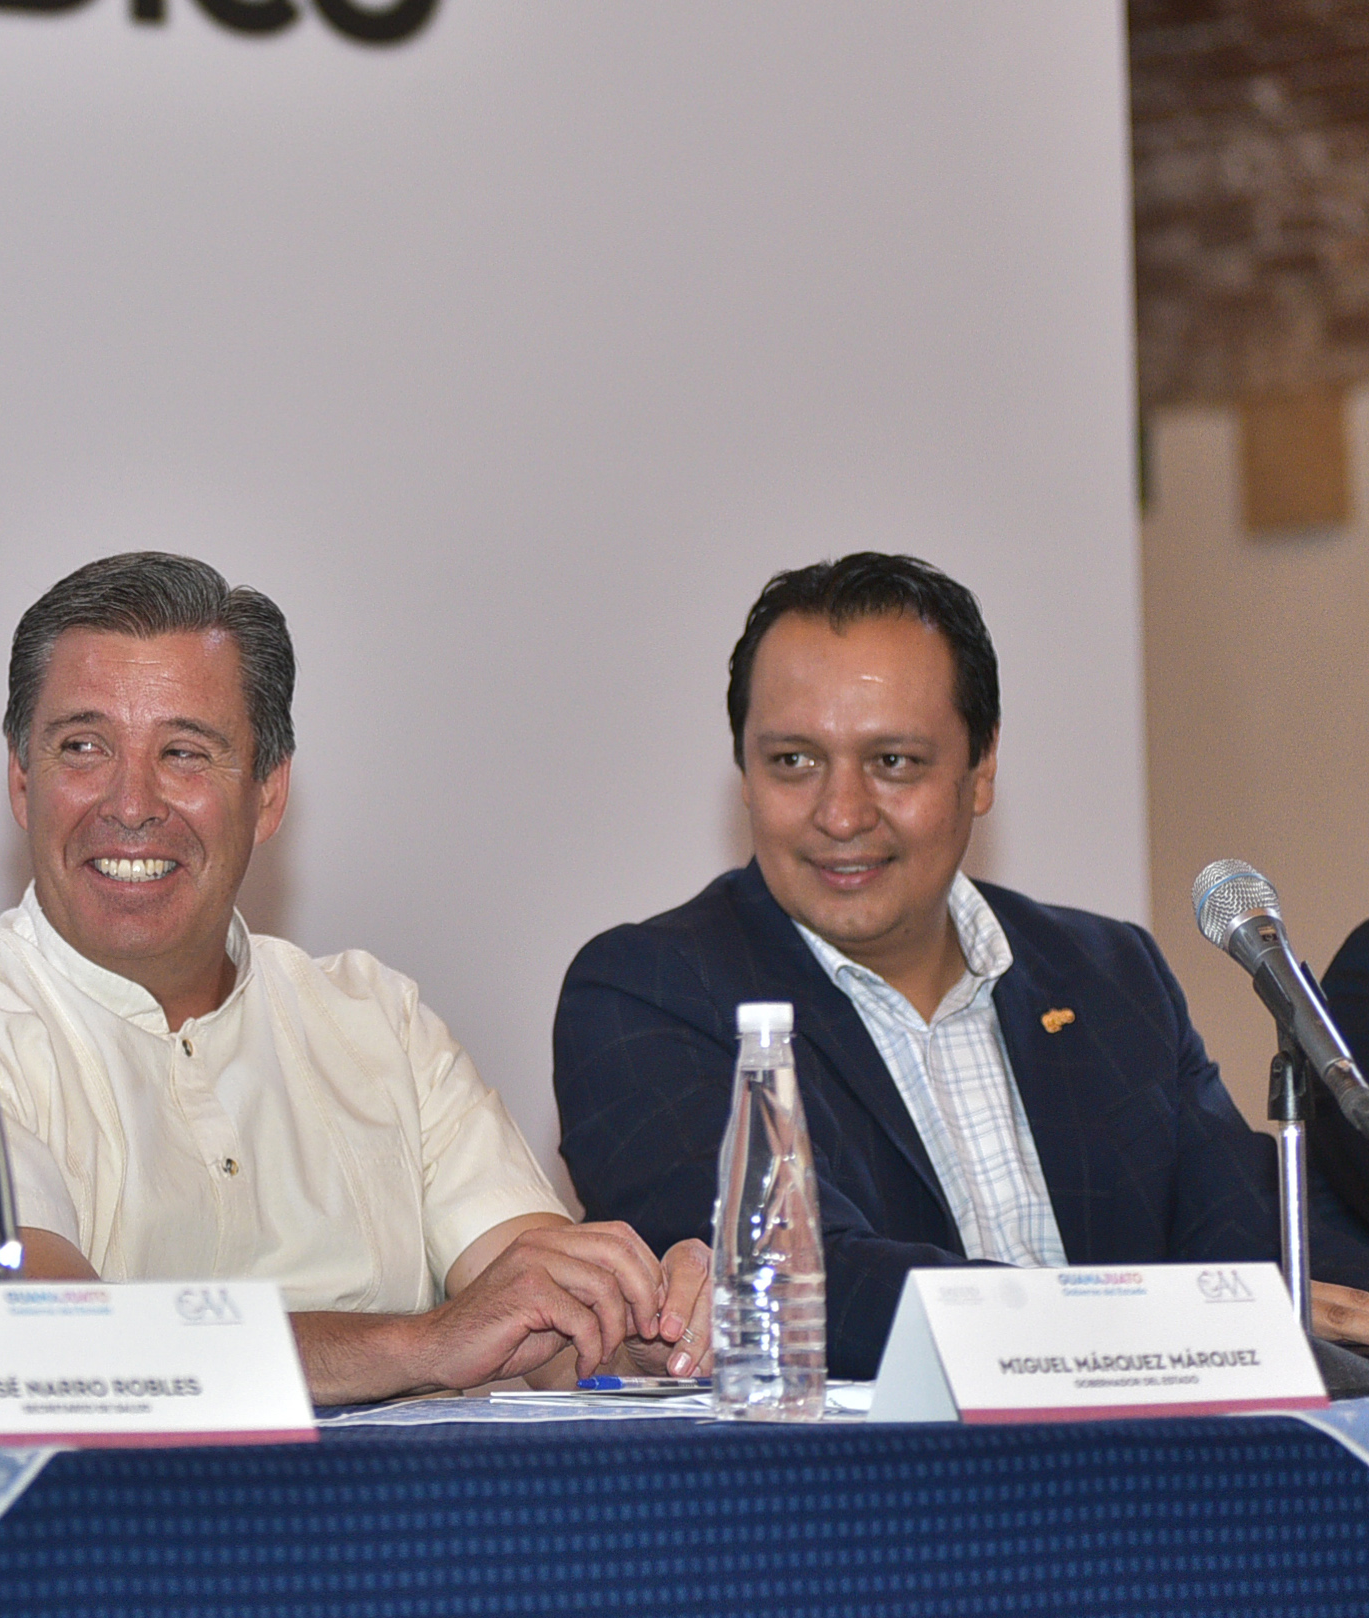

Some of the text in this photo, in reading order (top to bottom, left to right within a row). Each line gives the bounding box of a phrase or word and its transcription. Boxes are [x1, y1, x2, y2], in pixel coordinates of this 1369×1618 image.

[998, 1348, 1260, 1374] MIGUEL MÁRQUEZ MÁRQUEZ
[23, 1378, 109, 1398] NARRO
[111, 1377, 203, 1397] ROBLES
